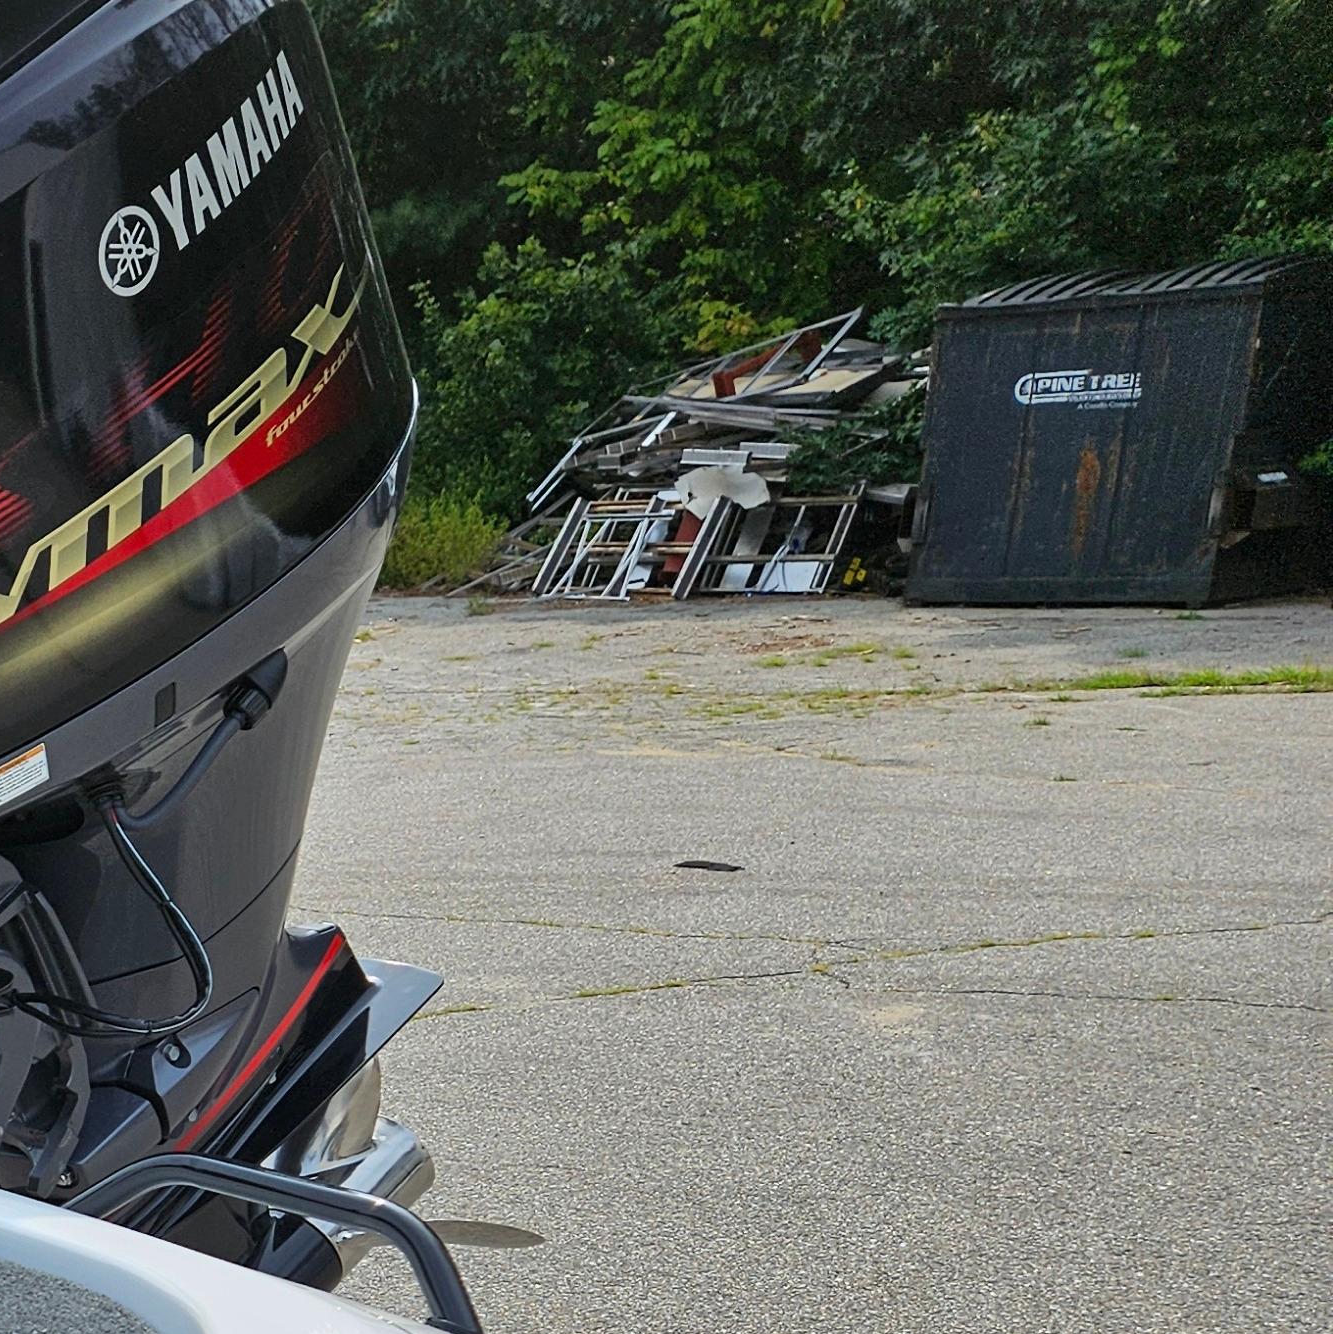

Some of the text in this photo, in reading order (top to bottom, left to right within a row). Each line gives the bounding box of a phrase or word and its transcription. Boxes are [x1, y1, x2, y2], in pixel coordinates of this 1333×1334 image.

[150, 49, 305, 252] YAMAHA
[1037, 372, 1141, 393] PINE TREE
